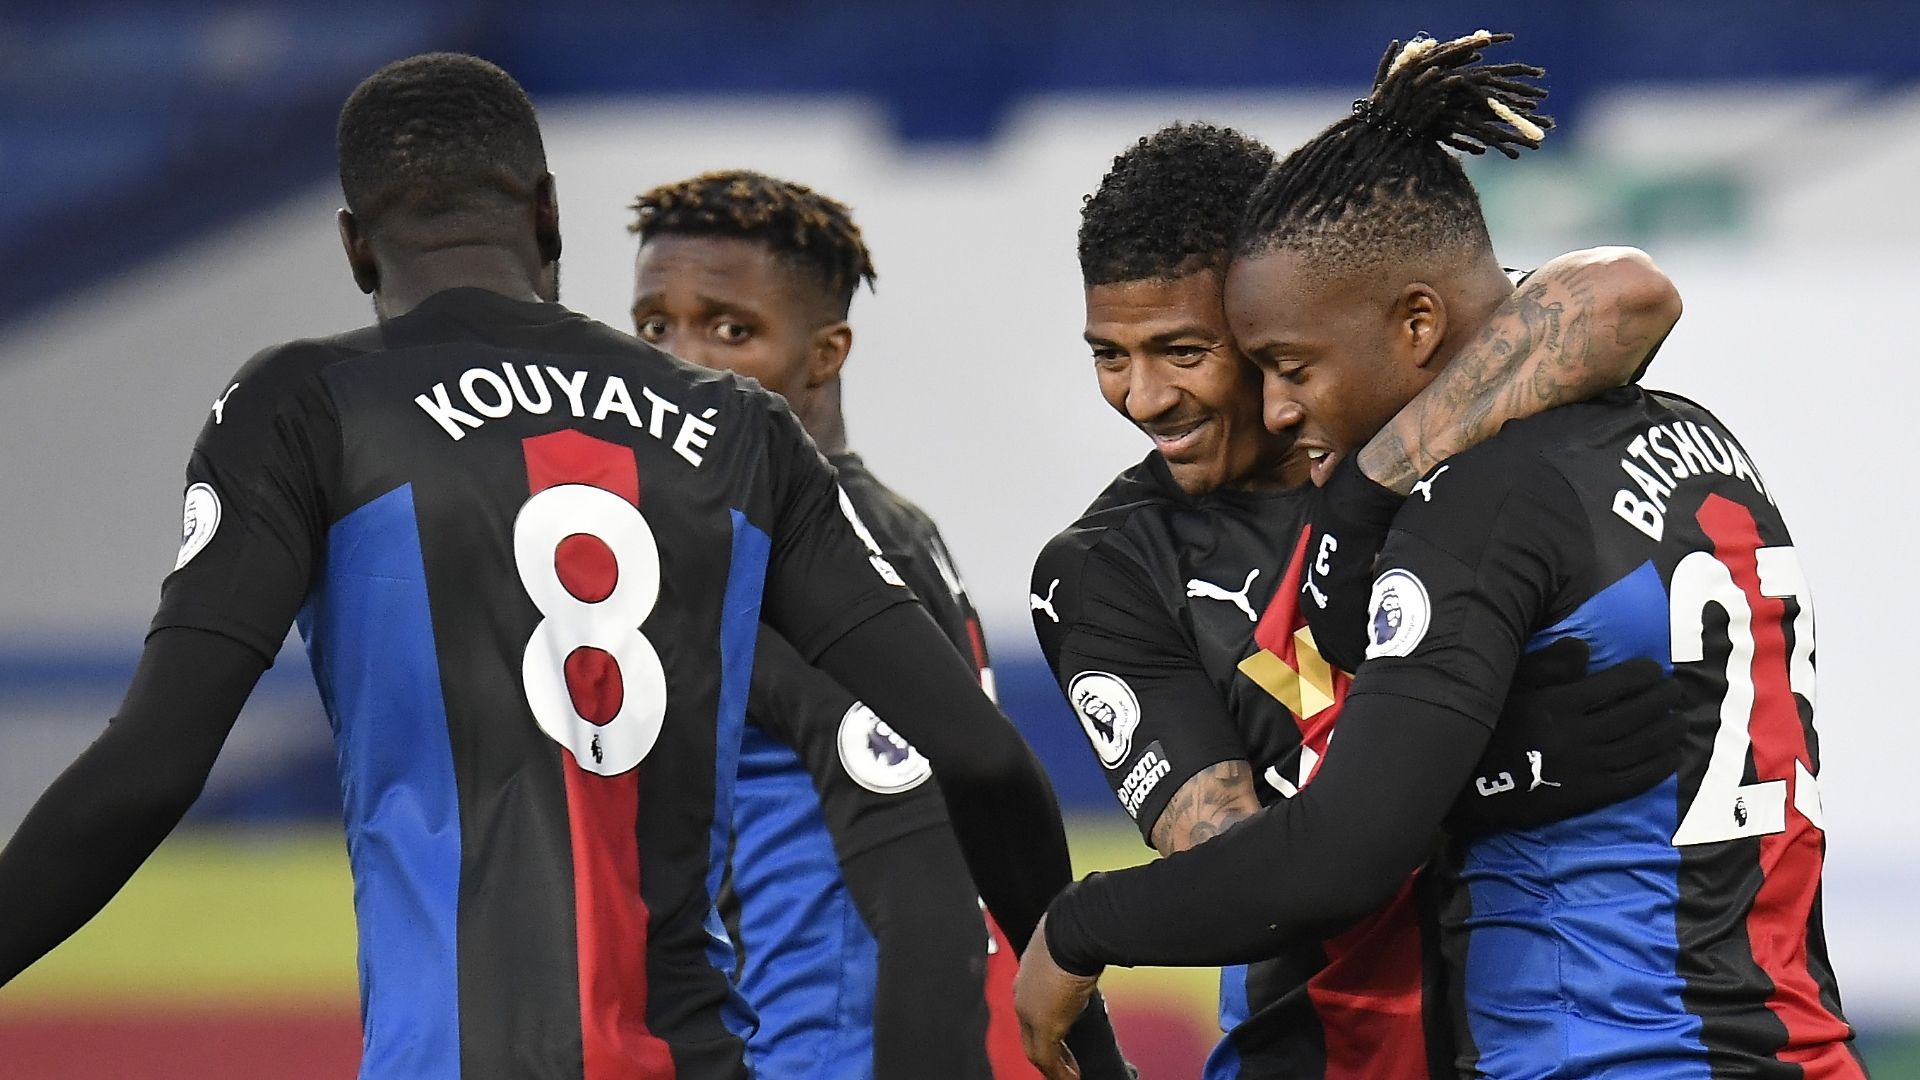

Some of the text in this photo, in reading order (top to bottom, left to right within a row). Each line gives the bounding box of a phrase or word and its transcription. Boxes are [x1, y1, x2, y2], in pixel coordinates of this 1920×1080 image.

[415, 362, 718, 467] KOUYATÉ
[1612, 421, 1775, 542] BATSHUA
[514, 484, 667, 777] 8
[1122, 751, 1158, 795] room
[1476, 772, 1515, 796] 3
